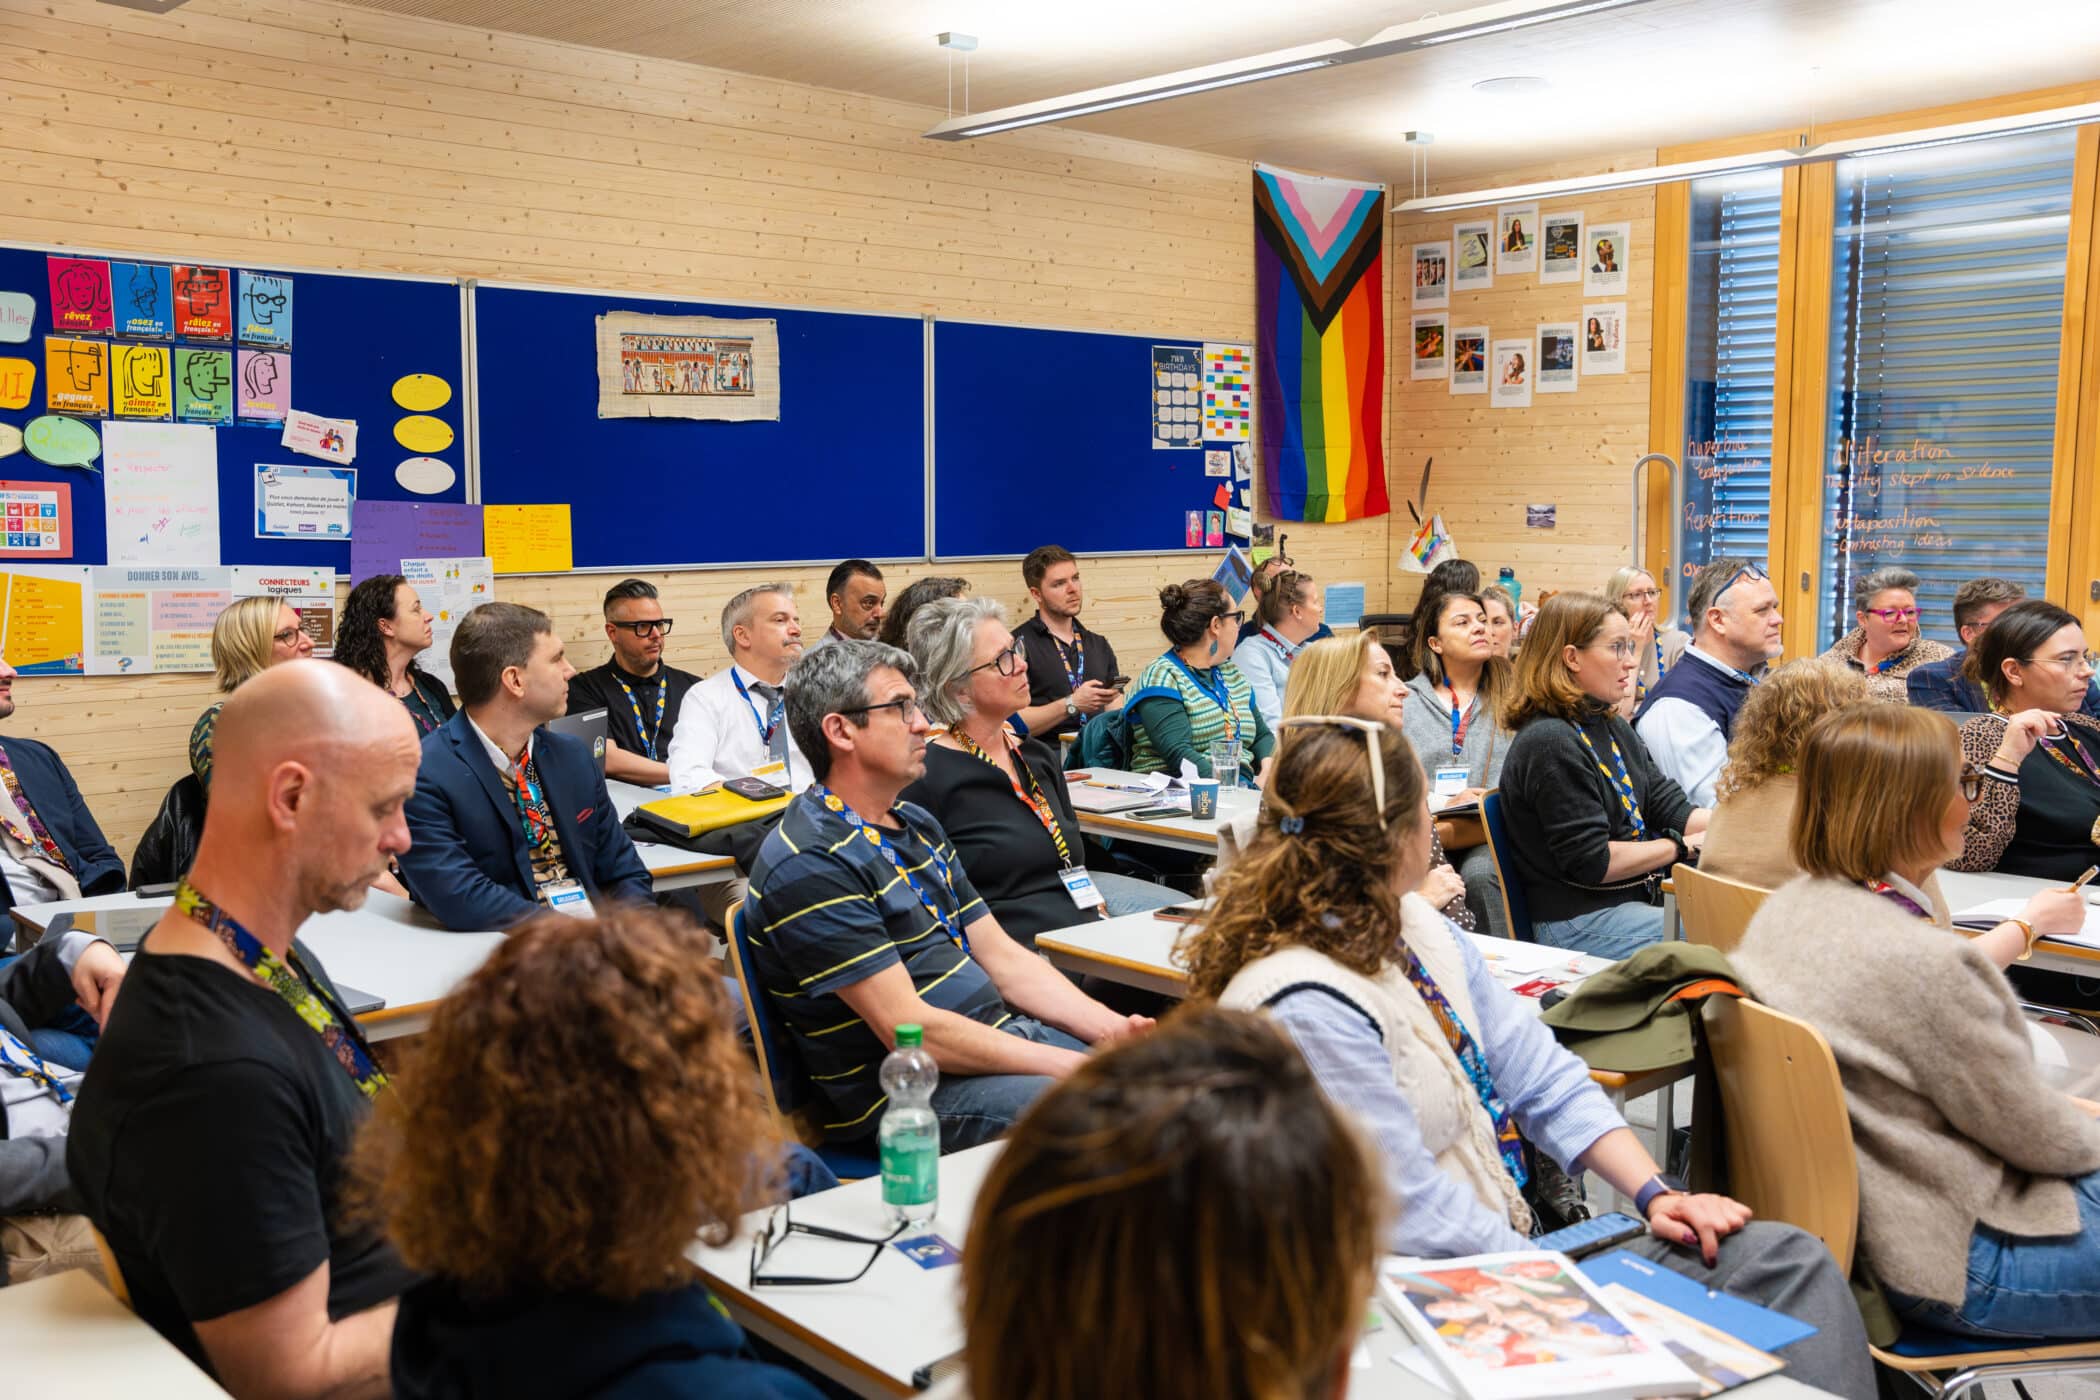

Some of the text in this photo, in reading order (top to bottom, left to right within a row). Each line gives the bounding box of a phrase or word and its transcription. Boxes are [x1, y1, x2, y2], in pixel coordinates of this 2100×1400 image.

[1159, 362, 1196, 372] BIRTHDAYS
[128, 571, 160, 581] DONNER
[162, 571, 179, 581] SON
[268, 586, 302, 594] logiques
